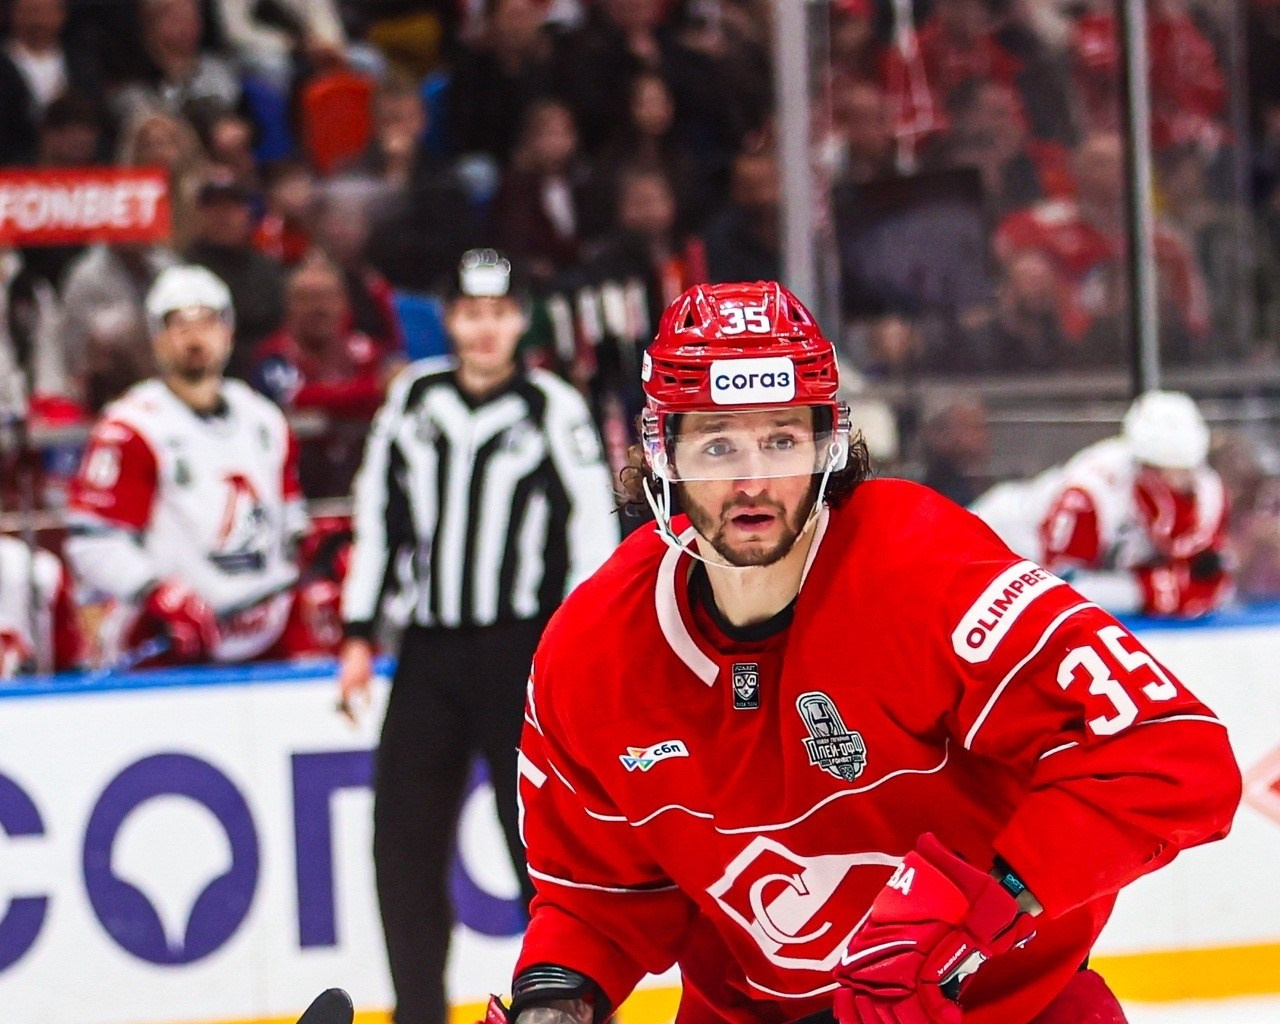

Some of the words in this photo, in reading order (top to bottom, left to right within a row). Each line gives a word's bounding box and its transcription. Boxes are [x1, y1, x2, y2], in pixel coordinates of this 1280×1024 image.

[720, 307, 771, 335] 35
[715, 372, 790, 390] согаз
[1057, 625, 1178, 735] 35
